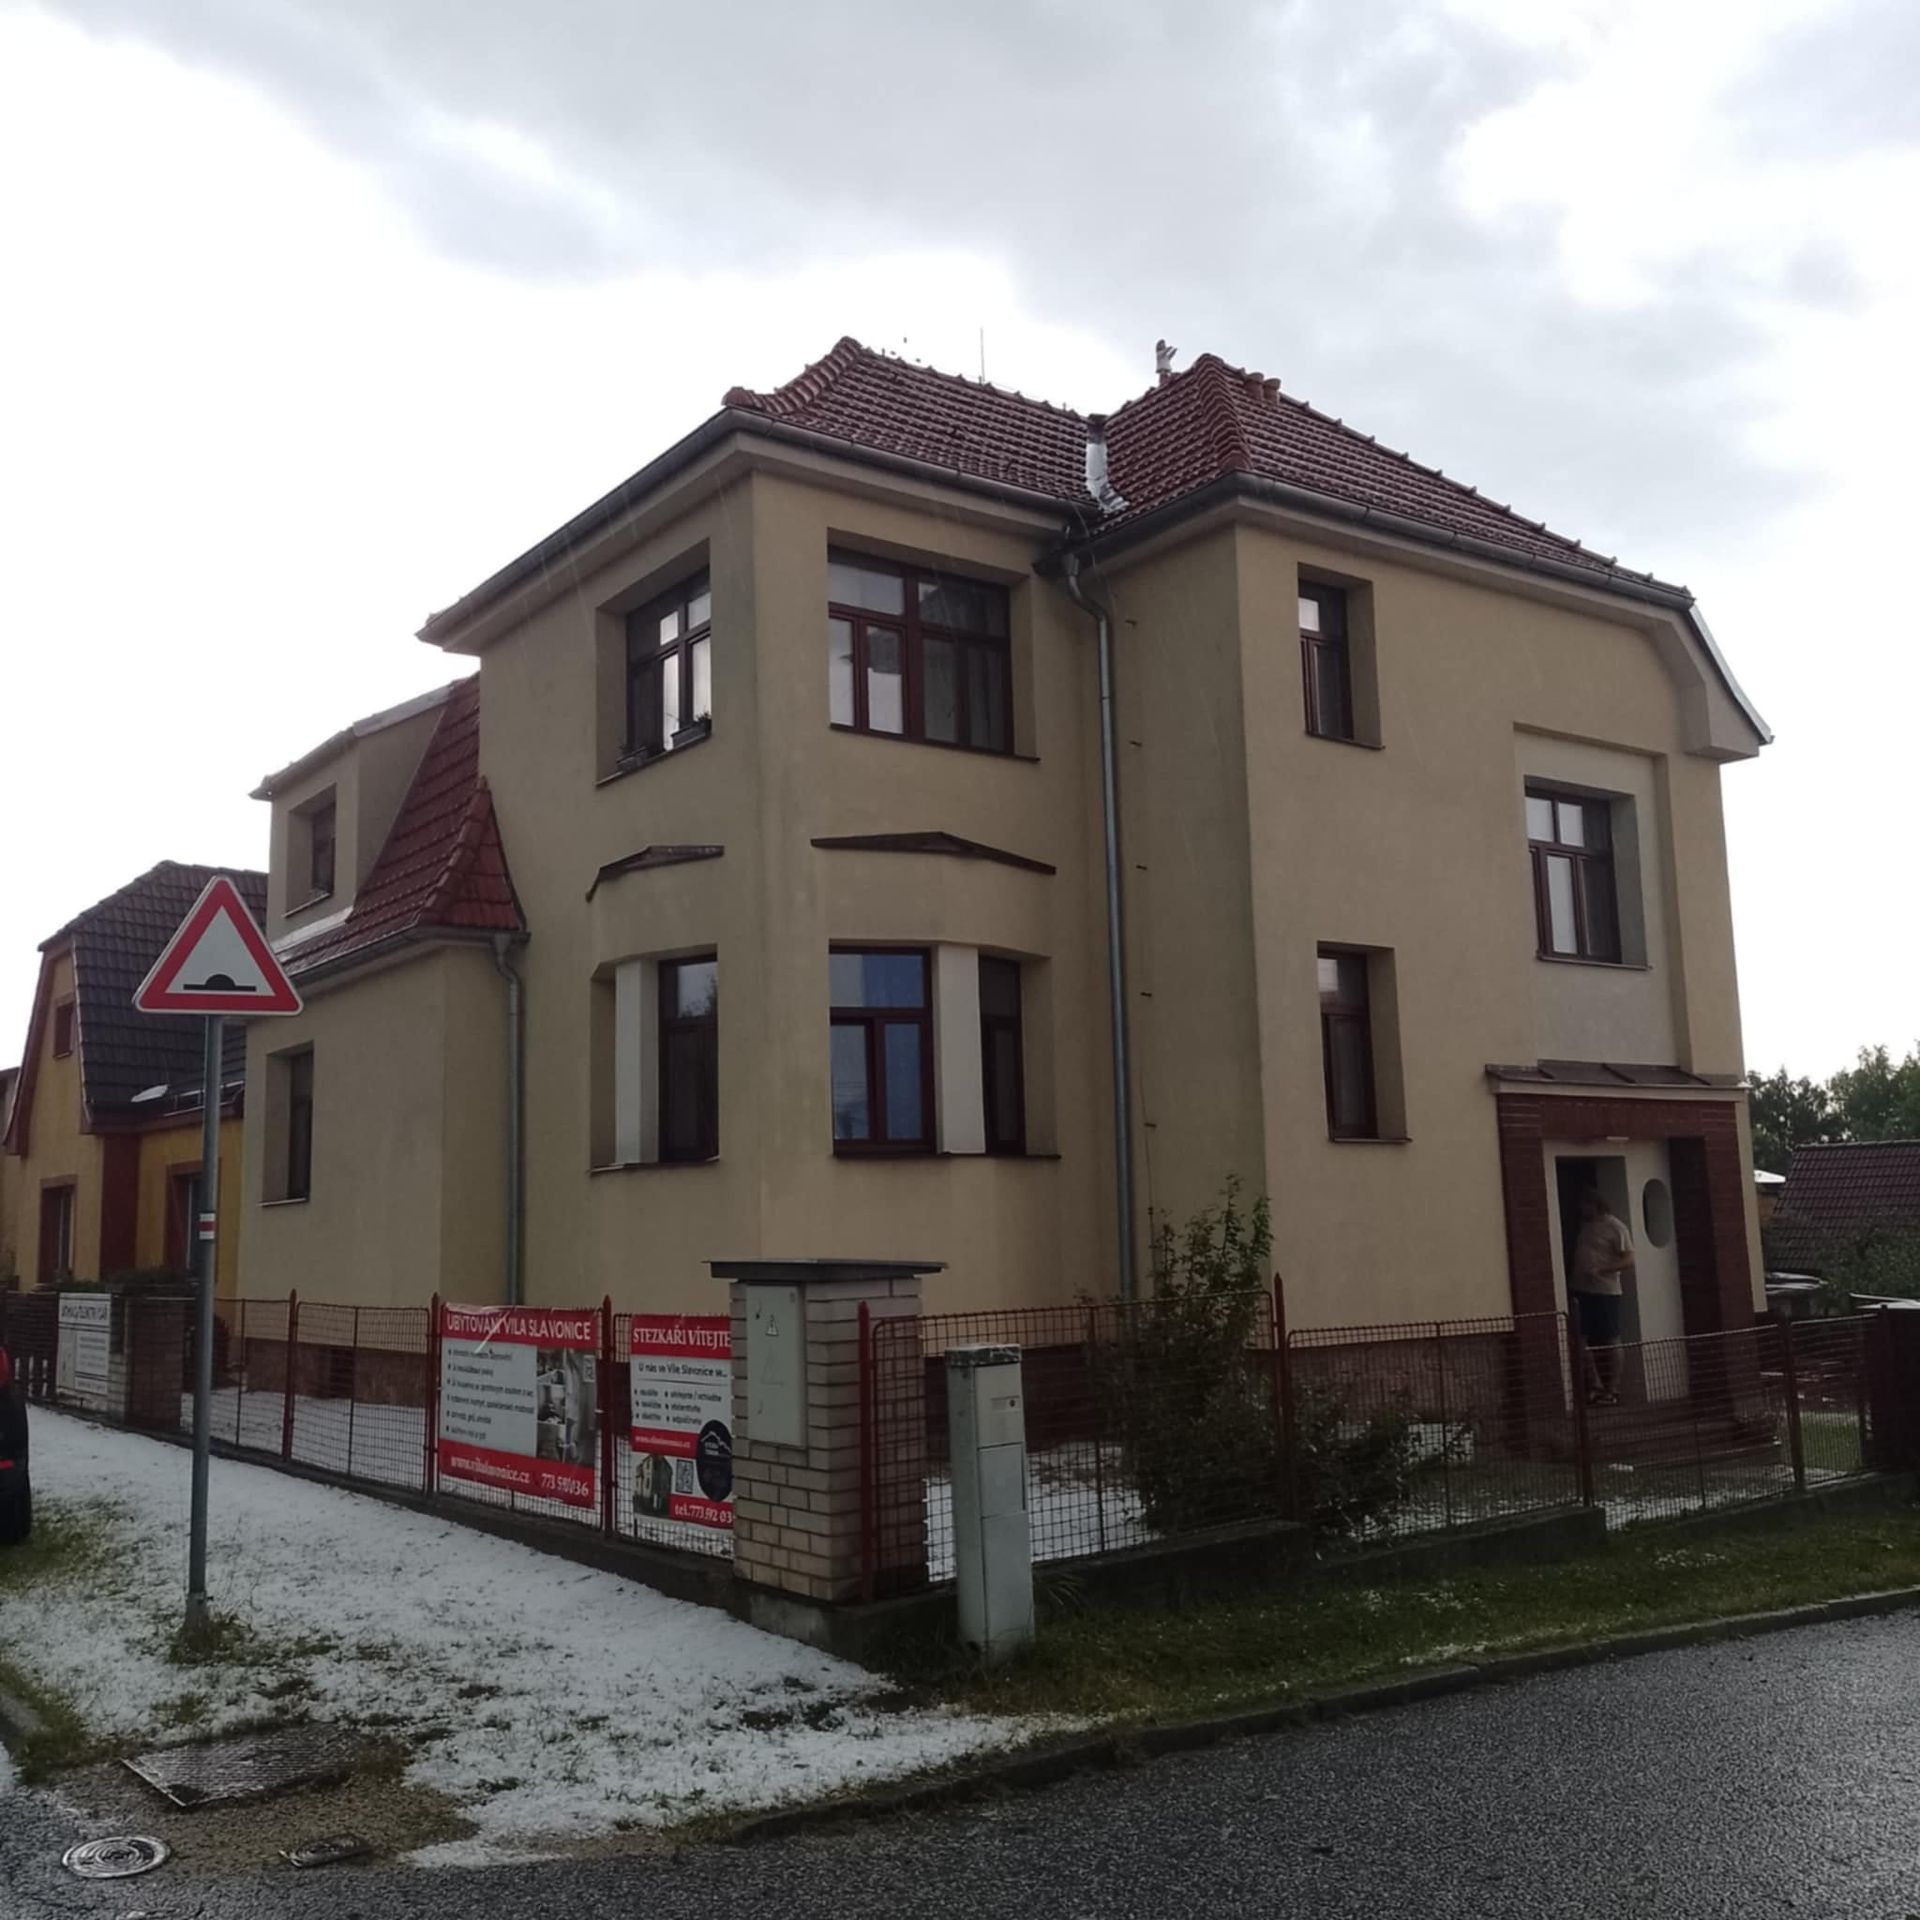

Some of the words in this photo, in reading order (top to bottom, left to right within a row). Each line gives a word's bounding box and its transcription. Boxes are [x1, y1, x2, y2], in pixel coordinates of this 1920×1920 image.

[504, 1317, 527, 1336] VILA
[528, 1319, 591, 1341] SLAVONICE
[633, 1324, 686, 1345] STEZKAŘI
[688, 1326, 732, 1350] VÍTEJTE
